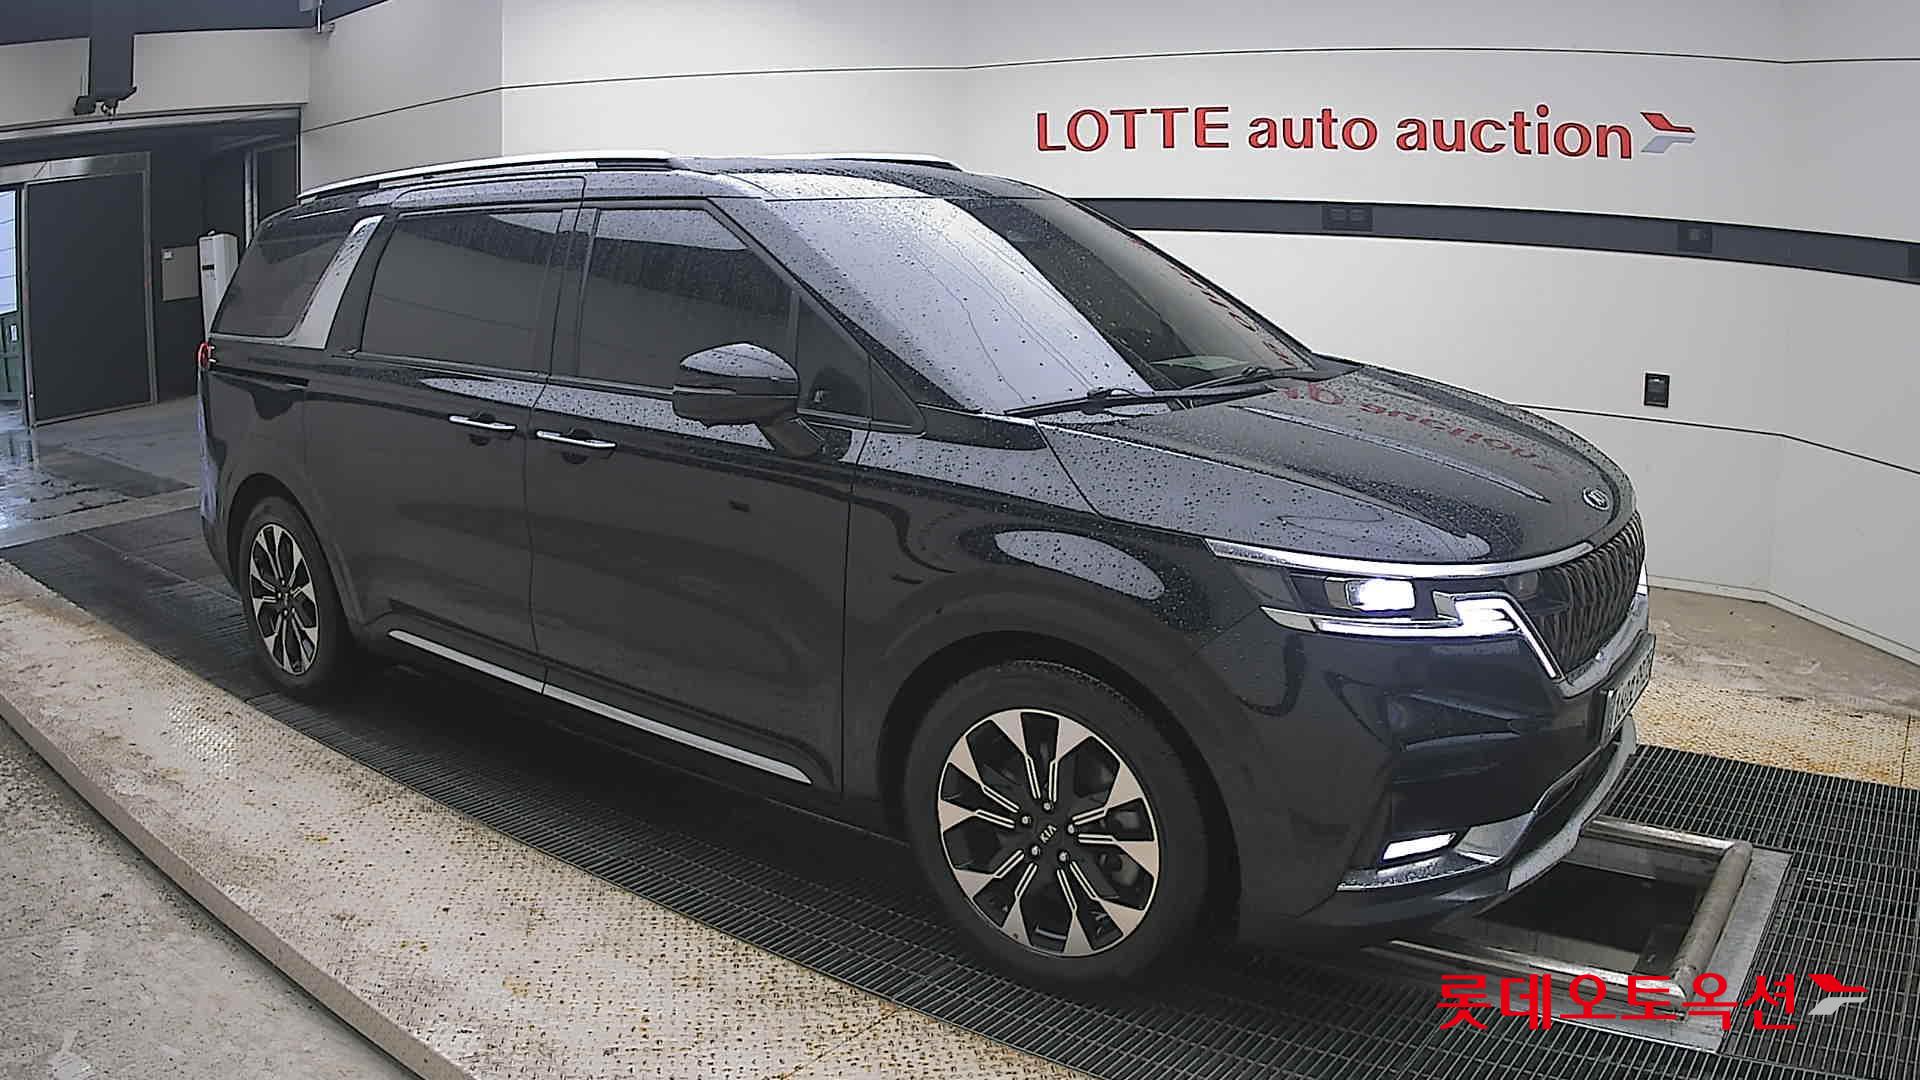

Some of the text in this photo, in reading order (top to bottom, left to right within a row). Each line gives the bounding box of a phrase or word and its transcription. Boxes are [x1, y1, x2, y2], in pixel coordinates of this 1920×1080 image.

[1036, 104, 1632, 159] LOTTE auto auction
